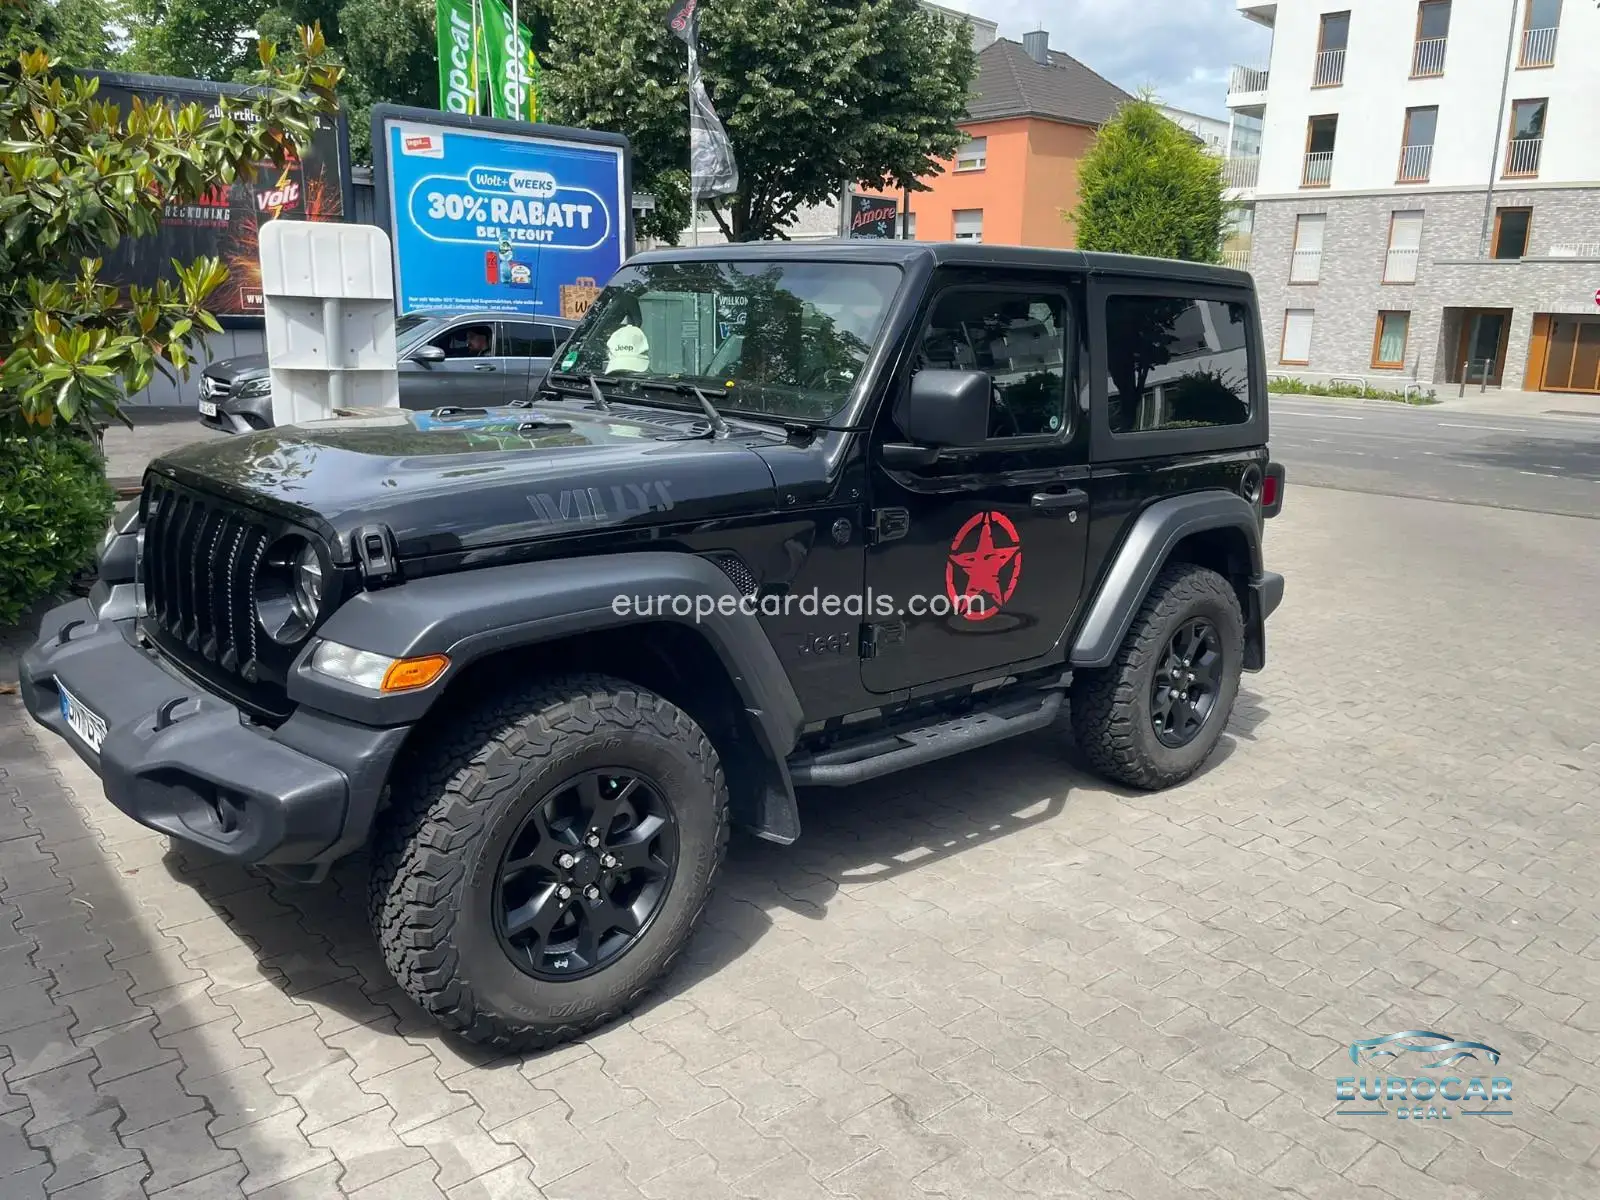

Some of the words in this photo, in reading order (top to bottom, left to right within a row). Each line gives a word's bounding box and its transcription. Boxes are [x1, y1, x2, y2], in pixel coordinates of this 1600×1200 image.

[476, 174, 509, 187] Wolt+
[513, 179, 553, 191] WEEKS
[164, 205, 231, 221] RECKONING
[490, 199, 593, 229] RABATT
[851, 207, 896, 231] Amore
[508, 227, 554, 242] TEGUT
[615, 344, 634, 352] Jeep
[526, 480, 674, 524] WILLYS
[796, 631, 851, 657] Jeep
